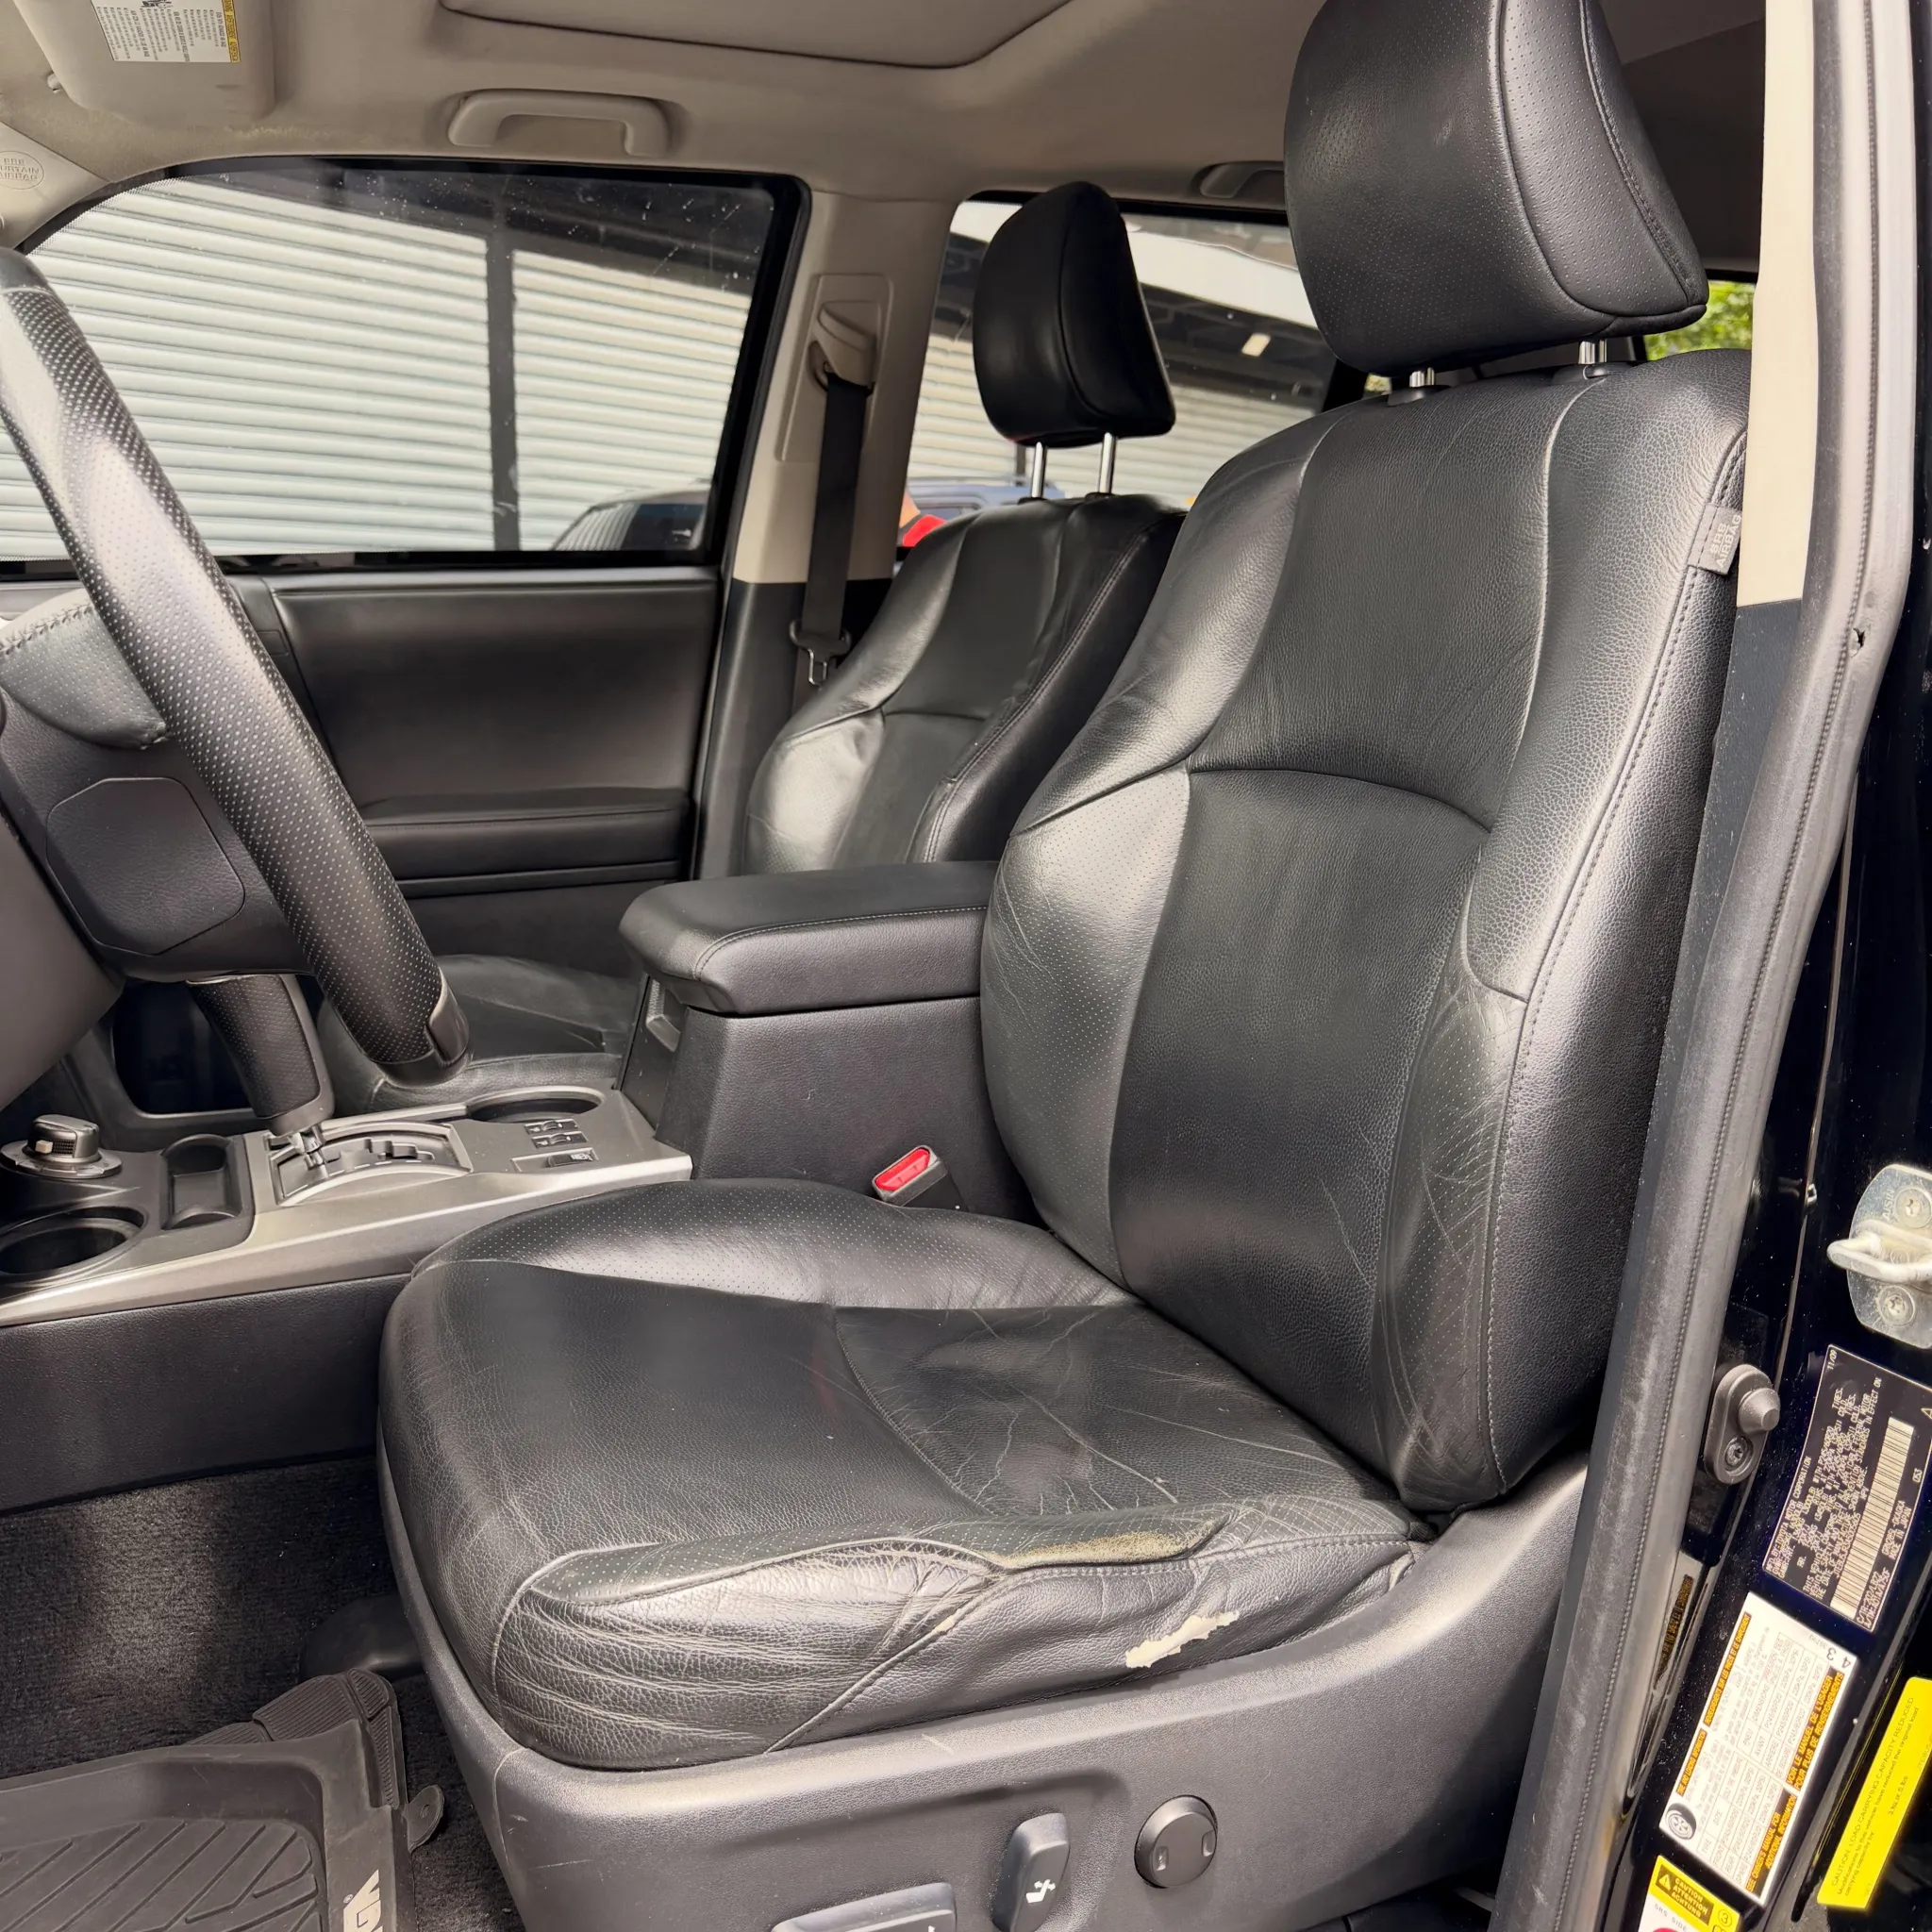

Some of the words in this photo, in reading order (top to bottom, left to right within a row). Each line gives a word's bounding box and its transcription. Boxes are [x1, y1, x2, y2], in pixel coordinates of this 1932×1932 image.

[0, 165, 40, 175] URTAIN
[1715, 514, 1741, 568] AIRBAG
[1881, 1189, 1895, 1221] AISIN
[1826, 1348, 1837, 1370] 11/09
[1873, 1376, 1882, 1388] ON
[1831, 1385, 1843, 1410] TIRES.
[1844, 1391, 1856, 1416] TIRES.
[1866, 1389, 1878, 1415] EFFECT
[1864, 1414, 1873, 1424] IN
[1854, 1425, 1870, 1463] STANDARDS
[1784, 1498, 1796, 1520] MOTOR
[1791, 1455, 1811, 1499] CORPORATION
[1802, 1574, 1814, 1593] THIS
[1809, 1545, 1824, 1574] VEHICLE
[1821, 1511, 1838, 1545] CONFORMS
[1832, 1501, 1841, 1511] TO
[1851, 1417, 1864, 1444] FEDERAL
[1858, 1392, 1870, 1416] MOTOR
[1835, 1504, 1847, 1525] THEFT
[1898, 1505, 1911, 1528] JAPAN
[1815, 1586, 1825, 1601] THE
[1821, 1567, 1833, 1586] DATE
[1828, 1556, 1837, 1568] OF
[1848, 1489, 1860, 1511] SHOWN
[1856, 1463, 1868, 1489] ABOVE.
[1829, 1526, 1840, 1541] AND
[1894, 1527, 1904, 1539] IN
[1820, 1541, 1834, 1568] SAFETY
[1888, 1541, 1900, 1560] MADE
[1808, 1567, 1824, 1597] VEHICLE
[1813, 1670, 1843, 1736] RENSEIGNEMENTS
[1814, 1674, 1833, 1712] L'USAGER
[1809, 1710, 1819, 1724] DE
[1797, 1724, 1814, 1755] MANUEL
[1808, 1734, 1819, 1748] DE
[1793, 1754, 1803, 1766] LE
[1801, 1747, 1814, 1769] PLUS
[1874, 1789, 1885, 1805] have
[1881, 1760, 1897, 1788] reduced
[1893, 1748, 1902, 1759] the
[1908, 1707, 1919, 1722] load
[1786, 1765, 1798, 1785] VOIR
[1792, 1767, 1807, 1790] POUR
[1846, 1824, 1861, 1846] LOAD
[1857, 1779, 1880, 1823] CARRYING
[1874, 1739, 1897, 1779] CAPACITY
[1892, 1696, 1914, 1737] REDUCED
[1763, 1833, 1782, 1870] ADDITIONAL
[1776, 1792, 1797, 1835] INFORMATION
[1745, 1876, 1756, 1892] SEE
[1761, 1824, 1776, 1851] MANUAL
[1771, 1811, 1781, 1827] FOR
[1674, 1877, 1704, 1903] CAUTION
[1844, 1869, 1859, 1895] carrying
[1671, 1891, 1702, 1919] ACHTUNG
[1673, 1885, 1708, 1916] ATTENTION
[1720, 1912, 1729, 1924] 3
